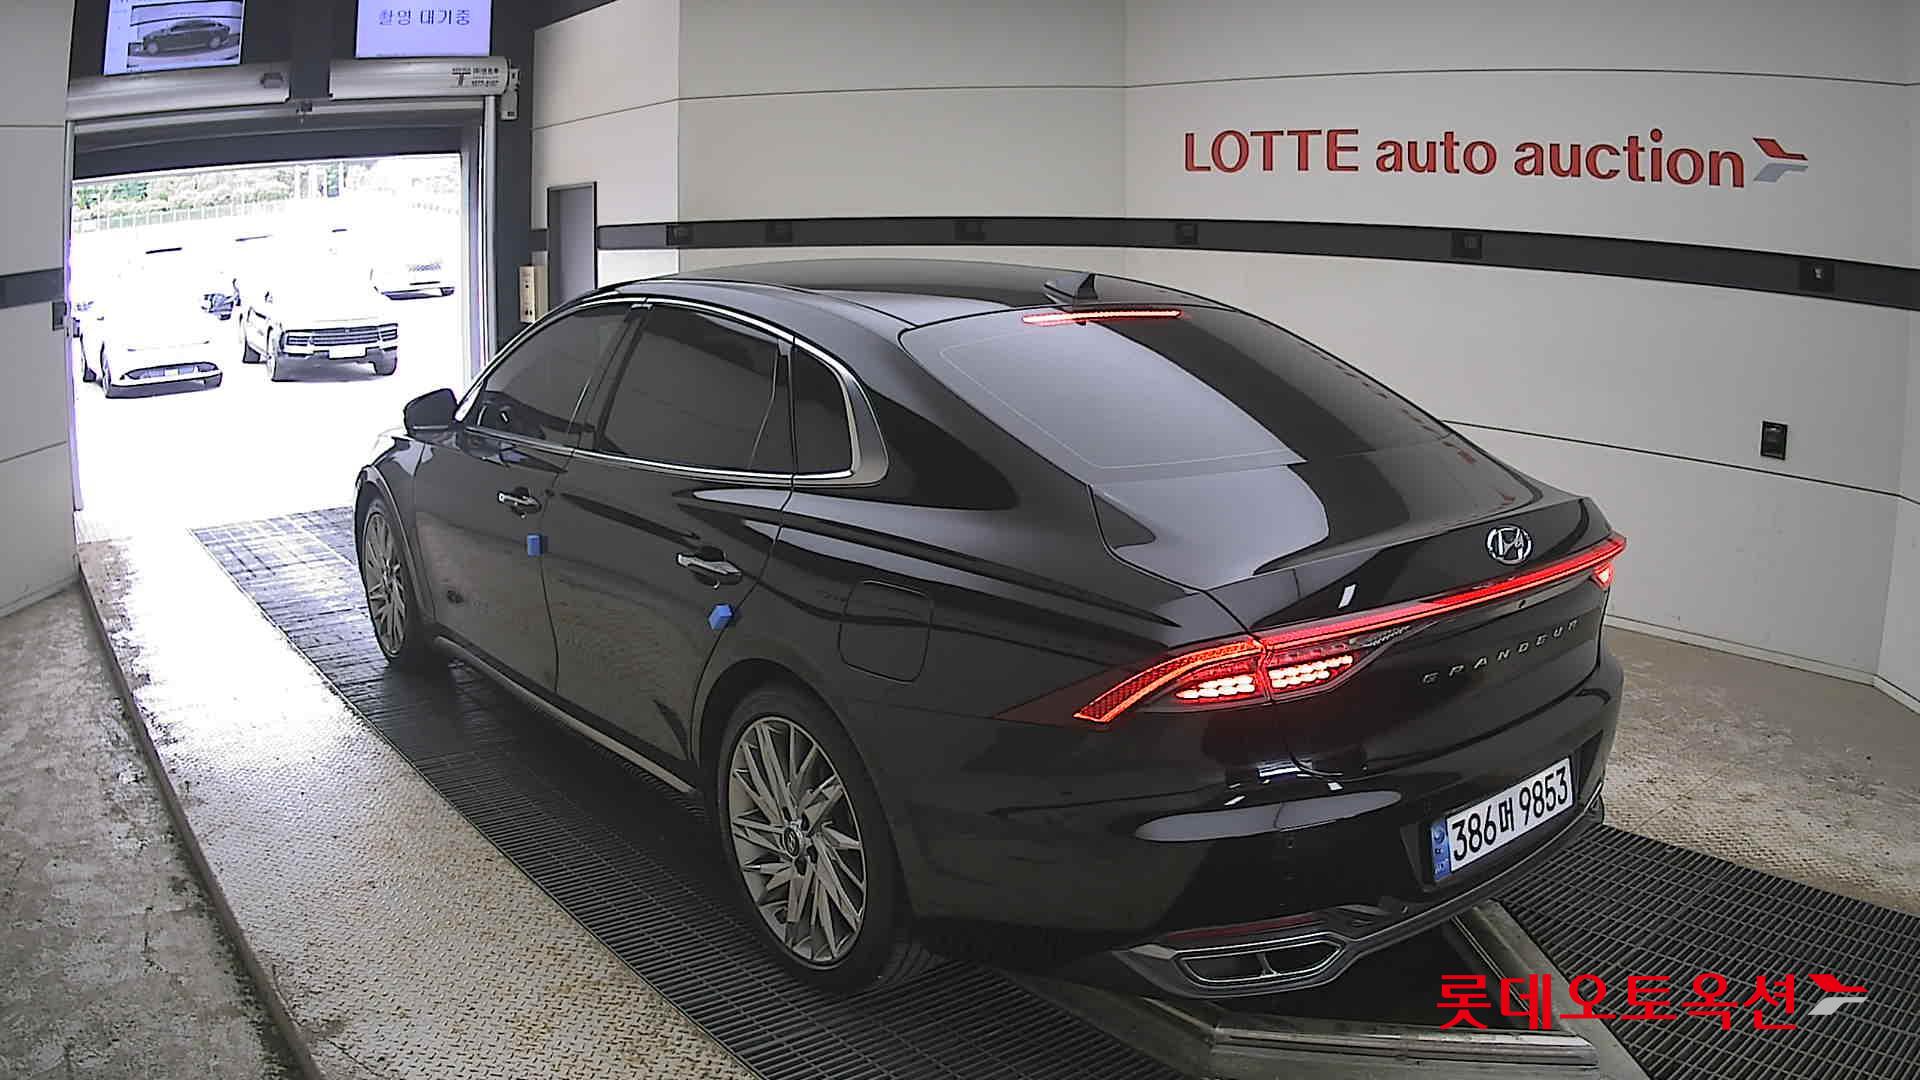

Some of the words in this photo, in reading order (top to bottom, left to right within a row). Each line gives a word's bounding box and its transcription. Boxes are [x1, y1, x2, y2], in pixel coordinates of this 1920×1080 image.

[419, 8, 471, 26] 대기중
[1185, 128, 1359, 173] LOTTE
[1376, 132, 1497, 175] auto
[1514, 128, 1745, 189] auction
[1422, 619, 1579, 685] GRANDEUR
[1519, 766, 1568, 826] 9853
